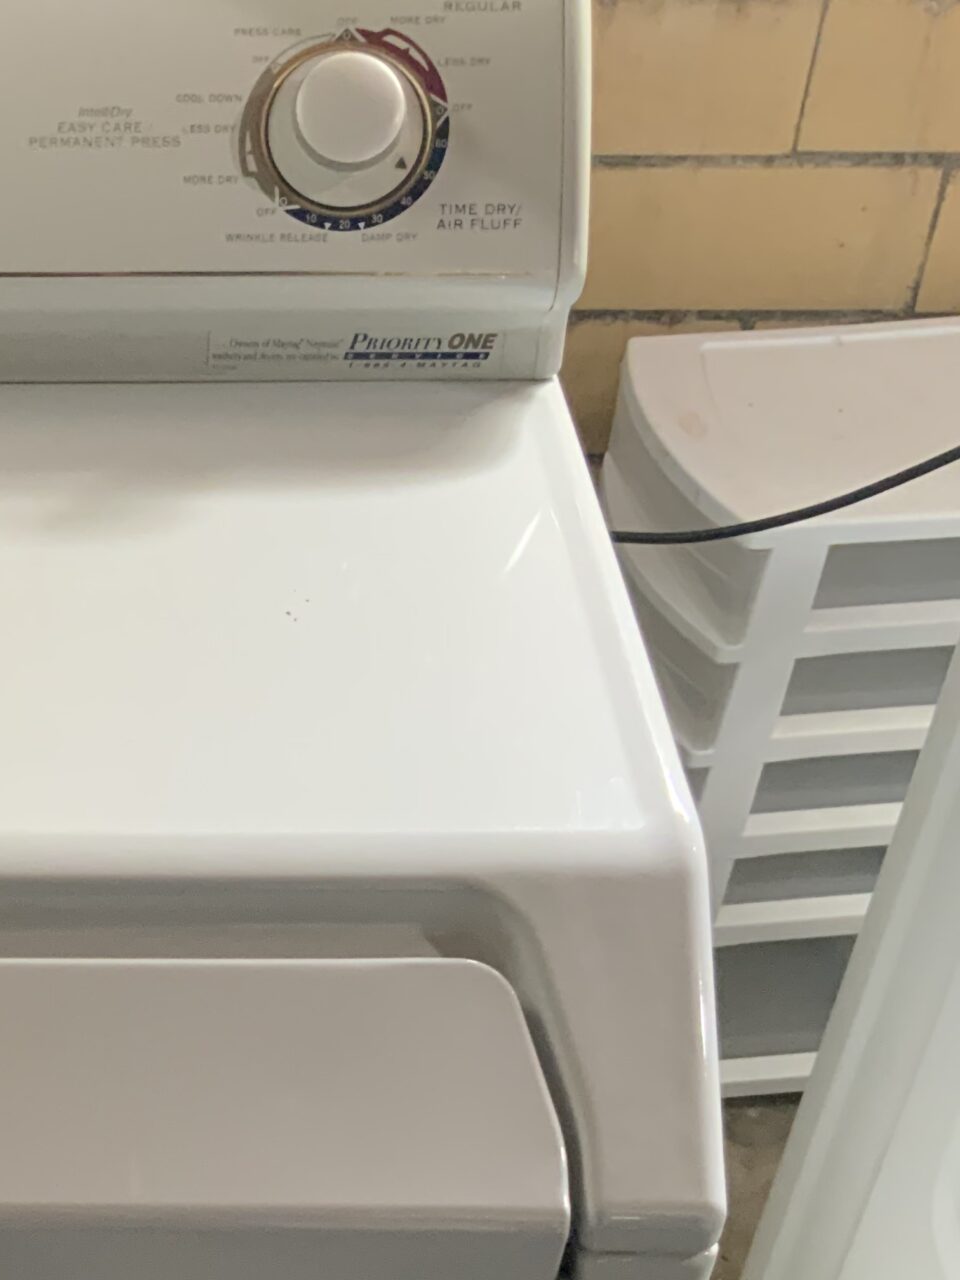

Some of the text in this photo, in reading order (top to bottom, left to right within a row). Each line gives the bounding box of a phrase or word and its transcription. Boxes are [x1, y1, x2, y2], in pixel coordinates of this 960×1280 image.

[443, 1, 522, 13] REGULAR
[234, 27, 268, 37] PRESS
[57, 121, 143, 134] EASY CARE
[28, 135, 182, 149] PERMANENT PRESS
[182, 174, 213, 185] MORE
[256, 207, 277, 218] OFF
[439, 202, 478, 216] TIME
[339, 219, 351, 230] 20
[371, 213, 384, 225] 30
[436, 217, 523, 231] AIR FLUFF
[350, 332, 443, 350] PRIORITY
[447, 332, 499, 350] ONE
